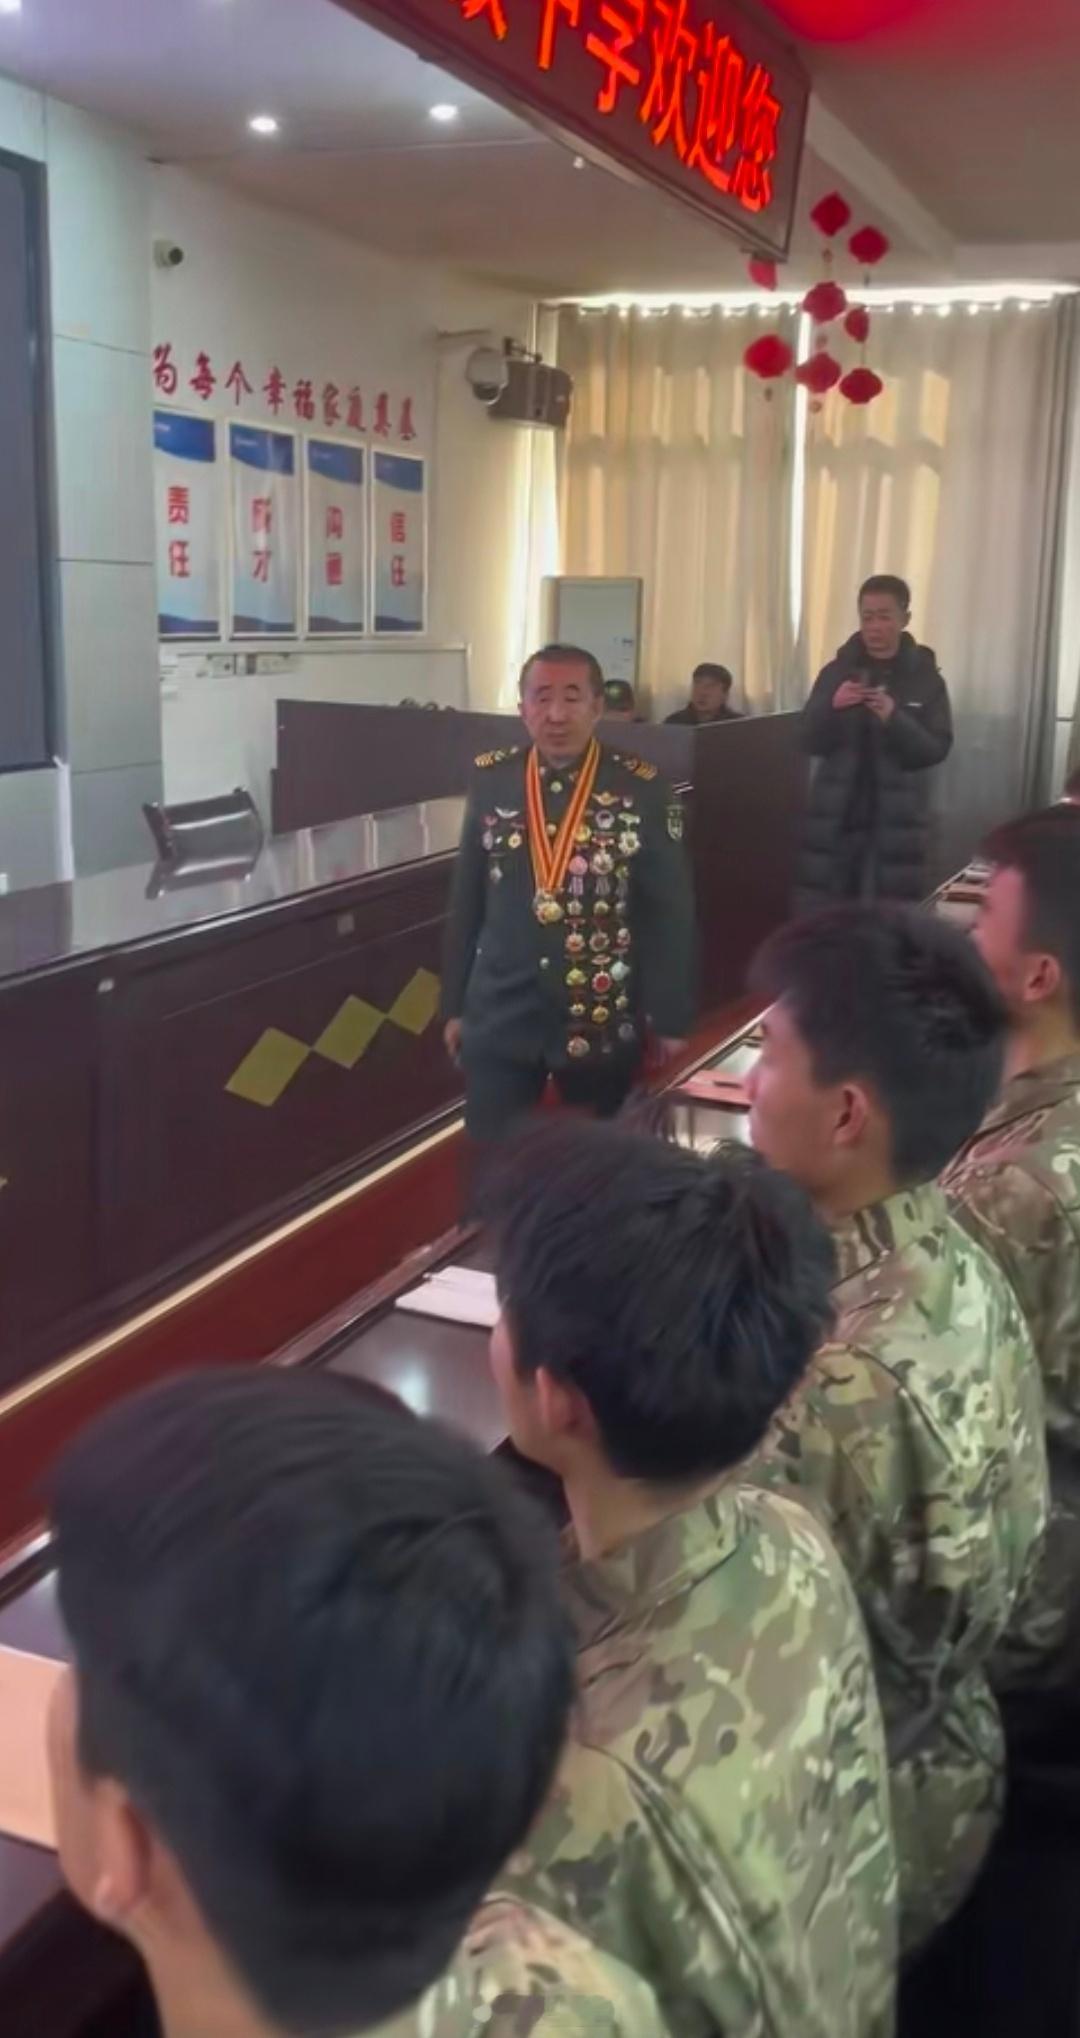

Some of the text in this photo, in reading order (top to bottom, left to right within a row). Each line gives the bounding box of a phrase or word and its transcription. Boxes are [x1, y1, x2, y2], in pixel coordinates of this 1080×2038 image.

[452, 0, 781, 213] 学欢迎您
[167, 485, 190, 579] 责任
[390, 511, 406, 587] 信任
